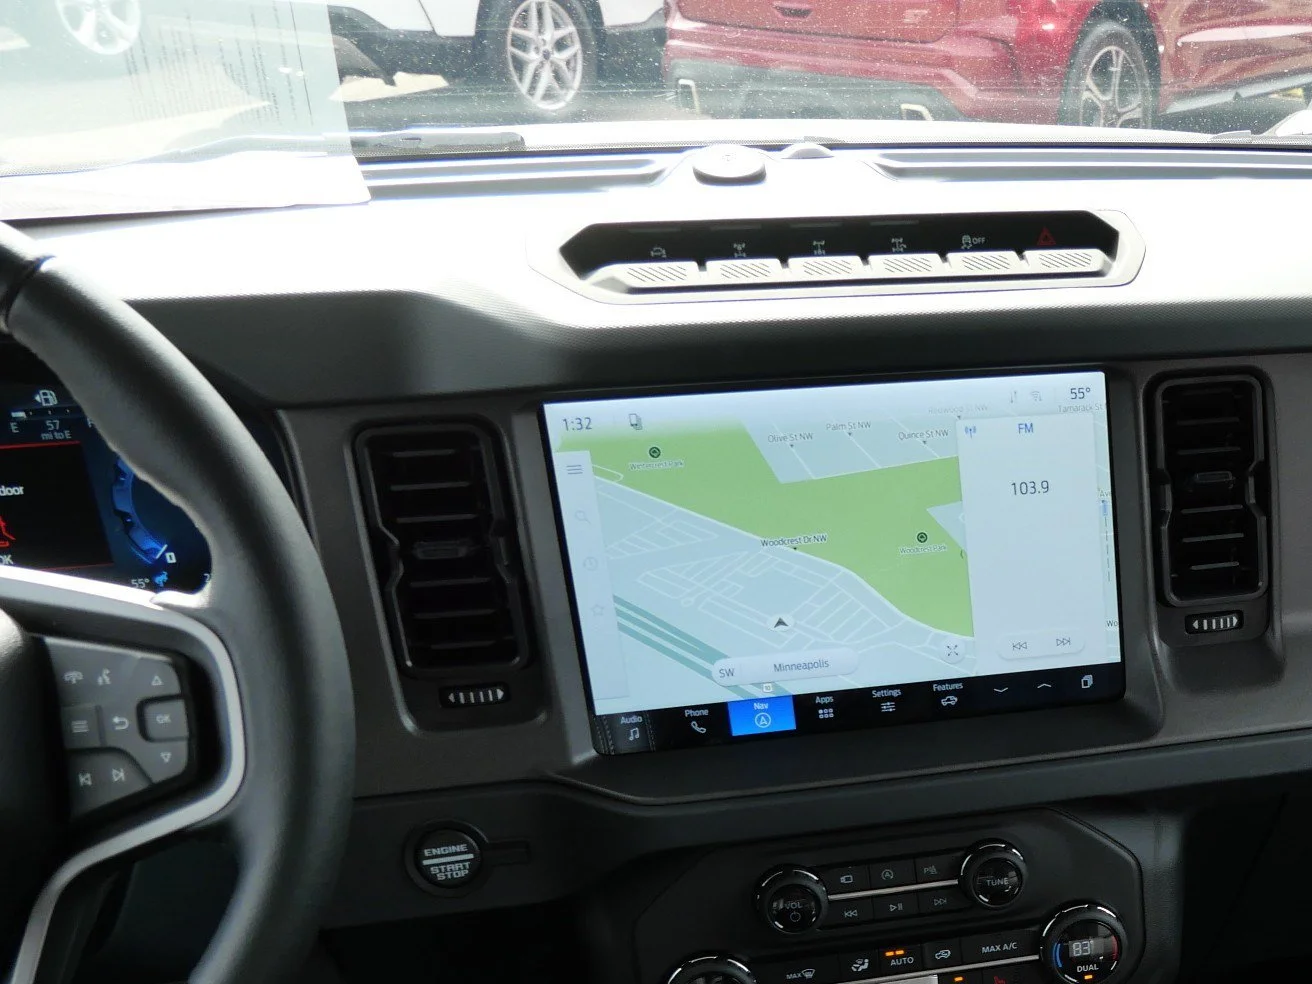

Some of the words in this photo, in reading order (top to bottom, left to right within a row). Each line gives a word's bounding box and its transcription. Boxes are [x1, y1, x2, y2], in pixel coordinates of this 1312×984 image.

[1070, 387, 1091, 400] 55°
[10, 422, 19, 433] E
[45, 420, 60, 431] 57
[562, 417, 592, 431] 1:32
[826, 423, 846, 431] Palm
[847, 421, 856, 430] St
[858, 420, 872, 429] NW
[1018, 423, 1034, 435] FM
[65, 430, 72, 439] E
[767, 433, 788, 443] Olive
[789, 433, 798, 442] St
[800, 432, 814, 440] NW
[898, 431, 924, 441] Quince
[925, 430, 934, 439] St
[935, 429, 949, 437] NW
[1011, 480, 1050, 496] 103.9
[761, 537, 802, 547] Woodcrest
[803, 535, 811, 543] Dr
[813, 534, 827, 542] NW
[774, 658, 830, 673] Minneapolis
[719, 668, 735, 678] SW
[933, 682, 964, 692] Features
[872, 688, 901, 699] Settings
[753, 702, 769, 710] Nav
[815, 696, 834, 705] Apps
[685, 708, 709, 717] Phone
[156, 715, 171, 724] OK
[620, 715, 643, 724] Audio
[424, 844, 468, 857] ENGINE
[430, 862, 471, 875] START
[437, 870, 469, 880] STOP
[986, 878, 1009, 887] TUNE
[784, 902, 803, 910] VOL
[982, 944, 1001, 954] MAX
[1003, 942, 1018, 951] A/C
[890, 956, 914, 967] AUTO
[1076, 964, 1099, 973] DUAL
